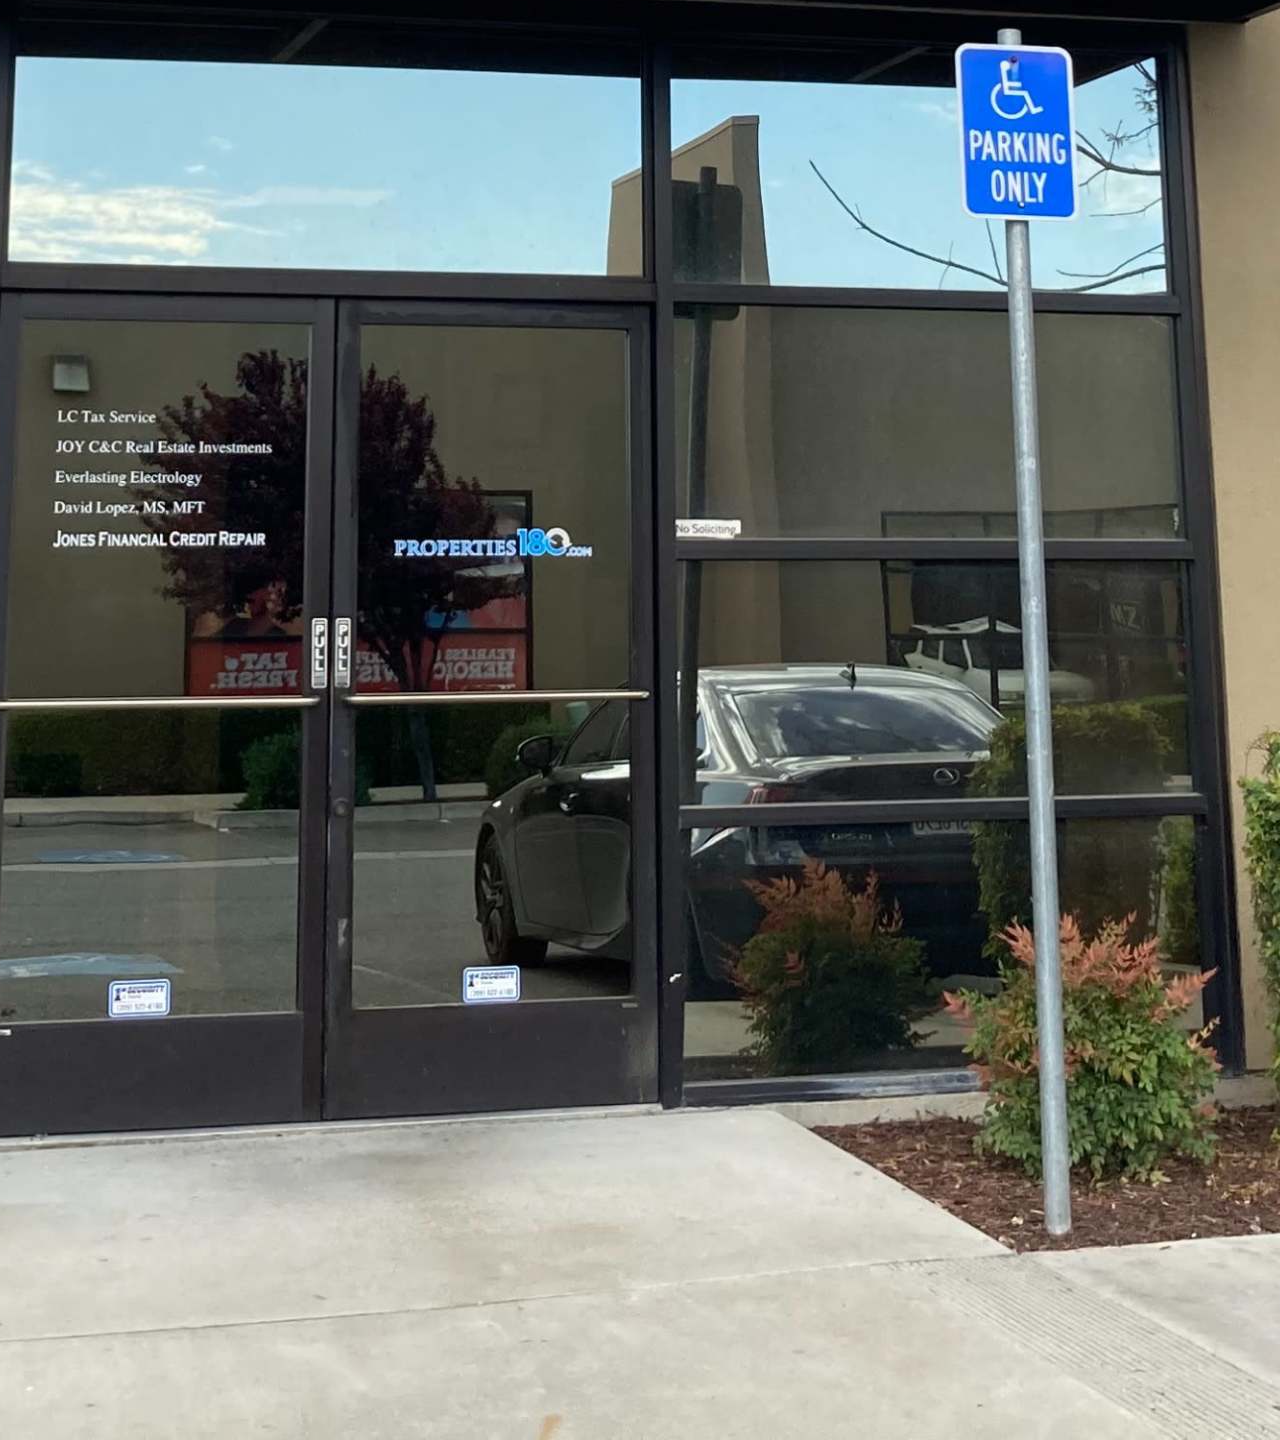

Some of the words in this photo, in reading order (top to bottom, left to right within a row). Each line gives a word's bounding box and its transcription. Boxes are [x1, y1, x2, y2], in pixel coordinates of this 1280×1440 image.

[970, 129, 1067, 164] PARKING
[990, 169, 1047, 203] ONLY
[57, 410, 79, 423] LC
[82, 410, 106, 423] Tax
[109, 410, 157, 424] Service
[56, 440, 85, 453] JOY
[88, 440, 122, 453] C&C
[125, 441, 154, 454] Real
[157, 441, 196, 454] Estate
[198, 441, 273, 455] Investments
[55, 471, 127, 486] Everlasting
[130, 471, 203, 487] Electrology
[54, 501, 93, 515] David
[95, 501, 140, 517] Lopez,
[142, 501, 170, 517] MS,
[173, 501, 206, 514] MFT
[315, 624, 325, 671] PULL
[338, 624, 348, 671] PULL
